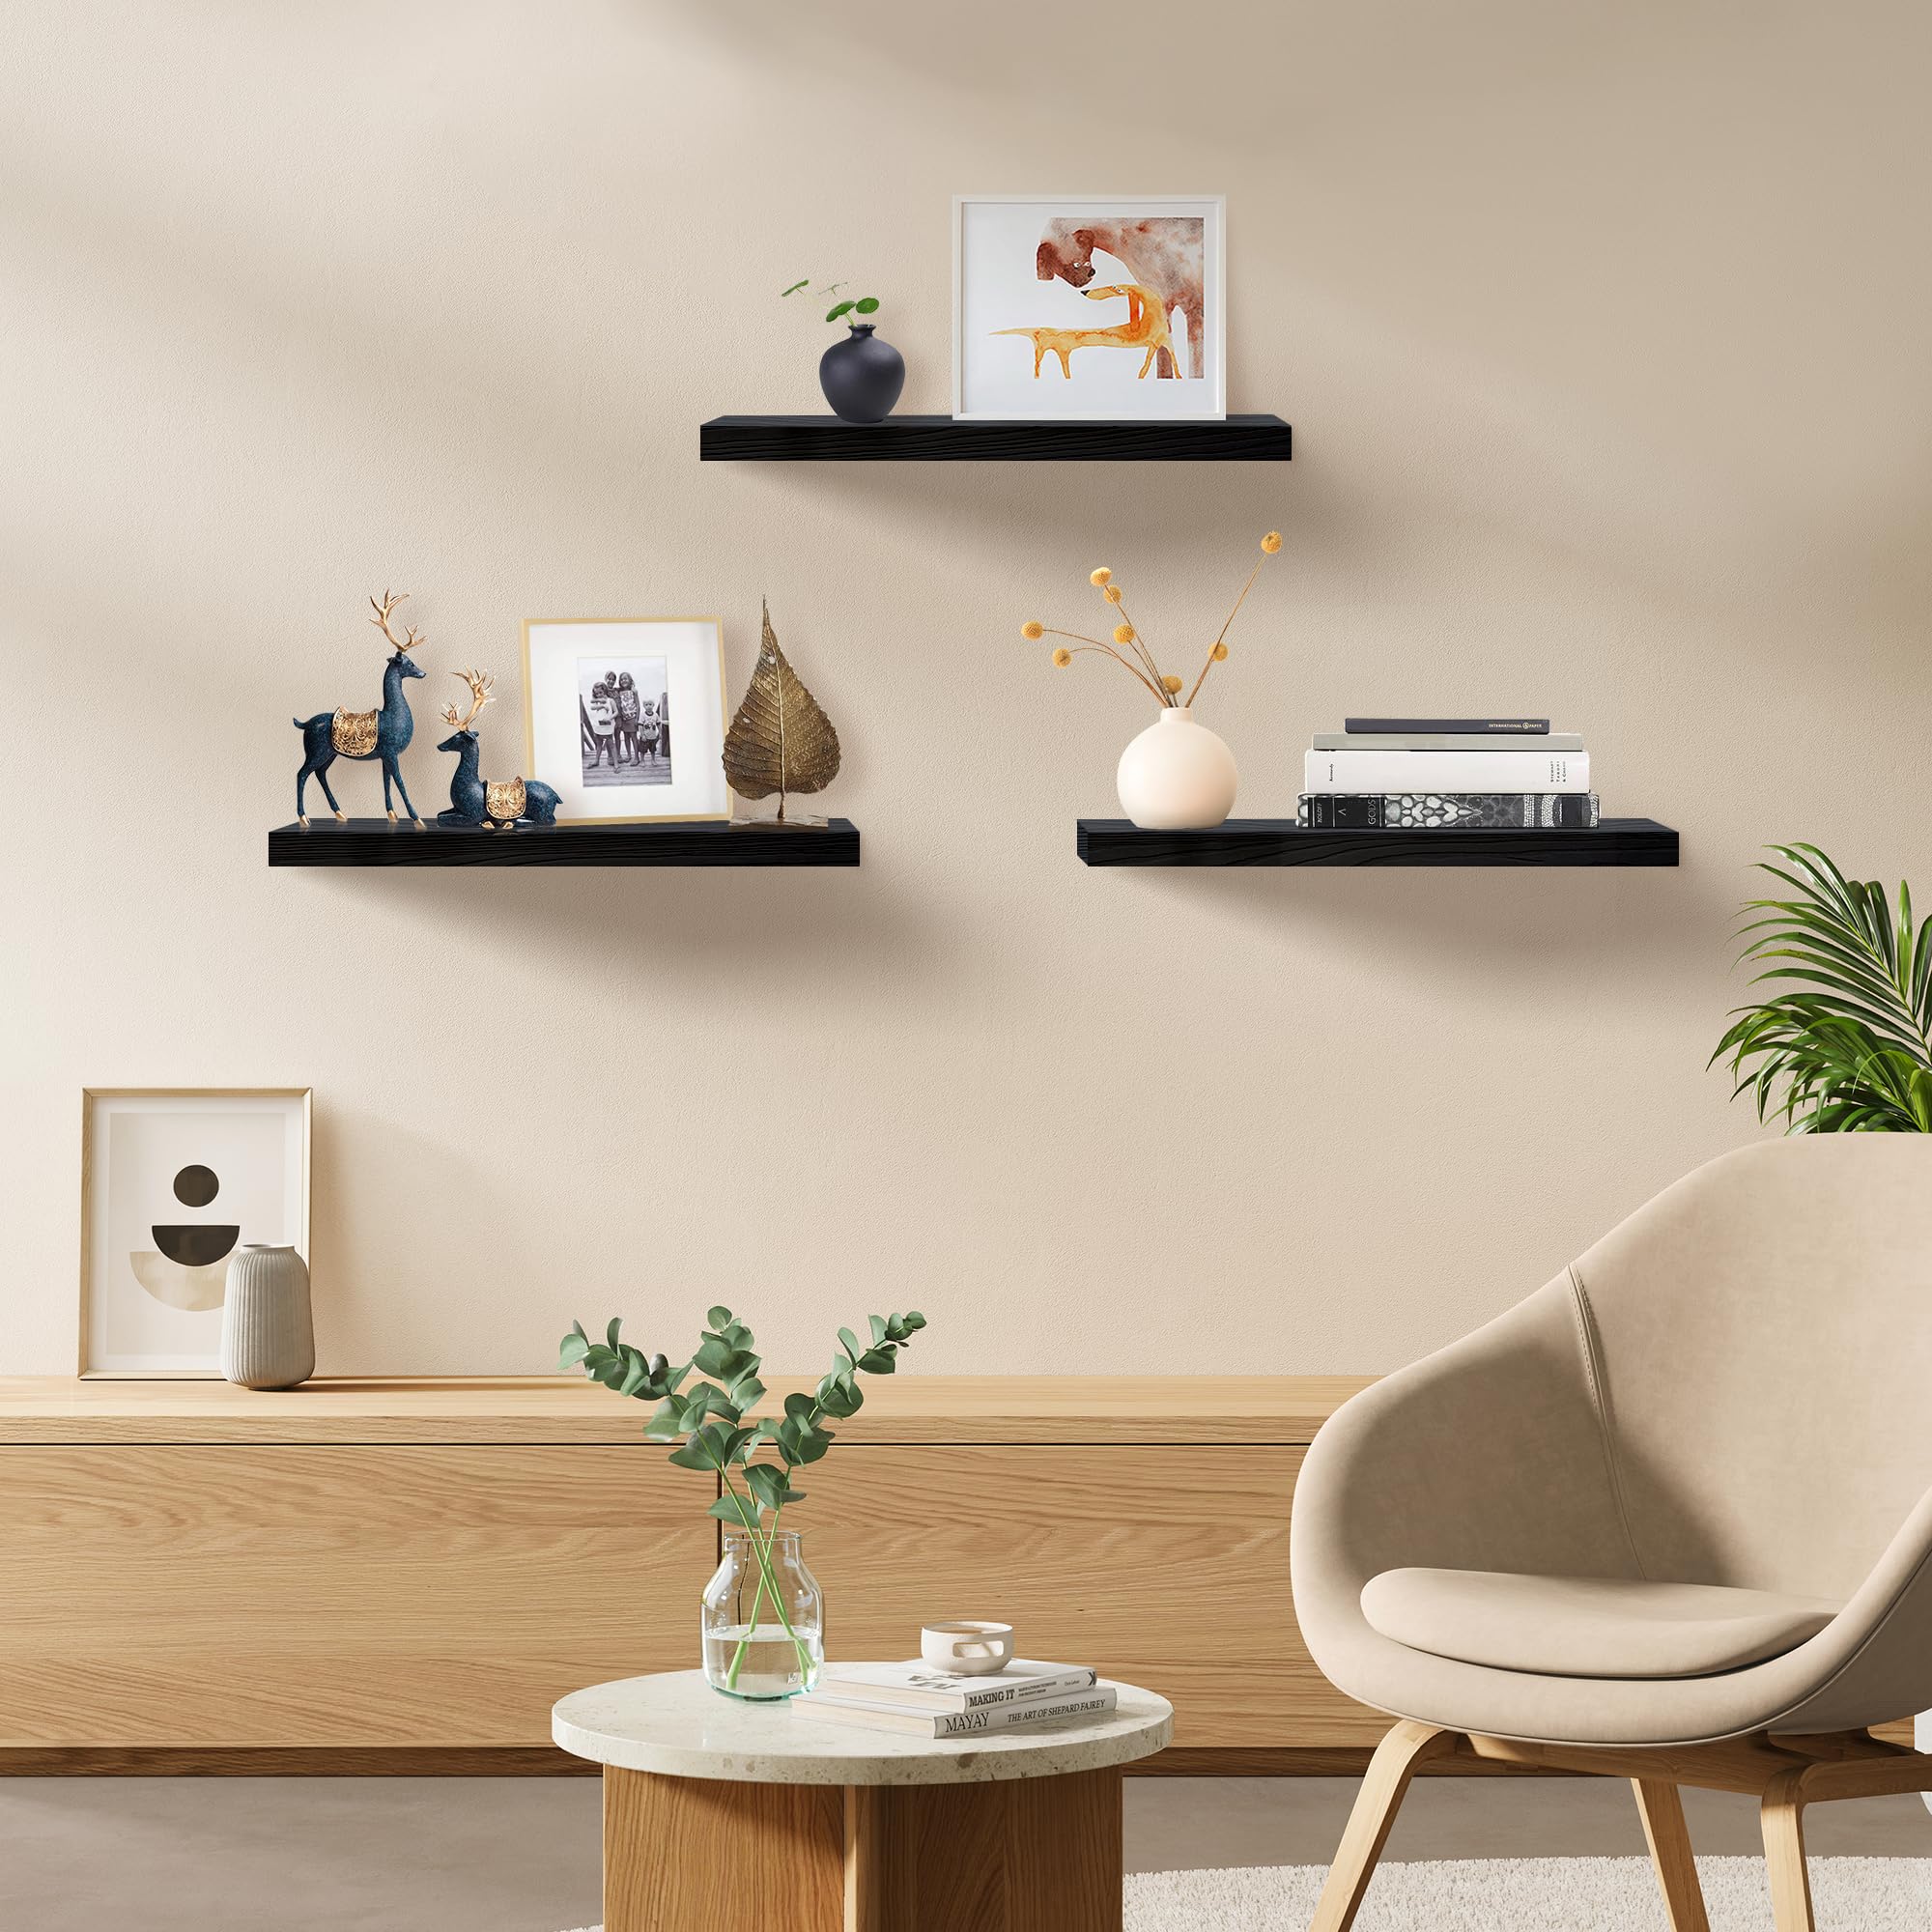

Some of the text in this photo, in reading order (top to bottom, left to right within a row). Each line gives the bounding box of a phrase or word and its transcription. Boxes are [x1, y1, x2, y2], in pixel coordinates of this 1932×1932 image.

[1367, 799, 1377, 825] GODS
[969, 1690, 1005, 1707] MAKING
[1006, 1689, 1015, 1700] IT
[945, 1712, 990, 1732] MAYAY
[1008, 1713, 1022, 1722] THE
[1022, 1710, 1037, 1720] ART
[1037, 1708, 1048, 1718] OF
[1048, 1703, 1080, 1717] SHEPARD
